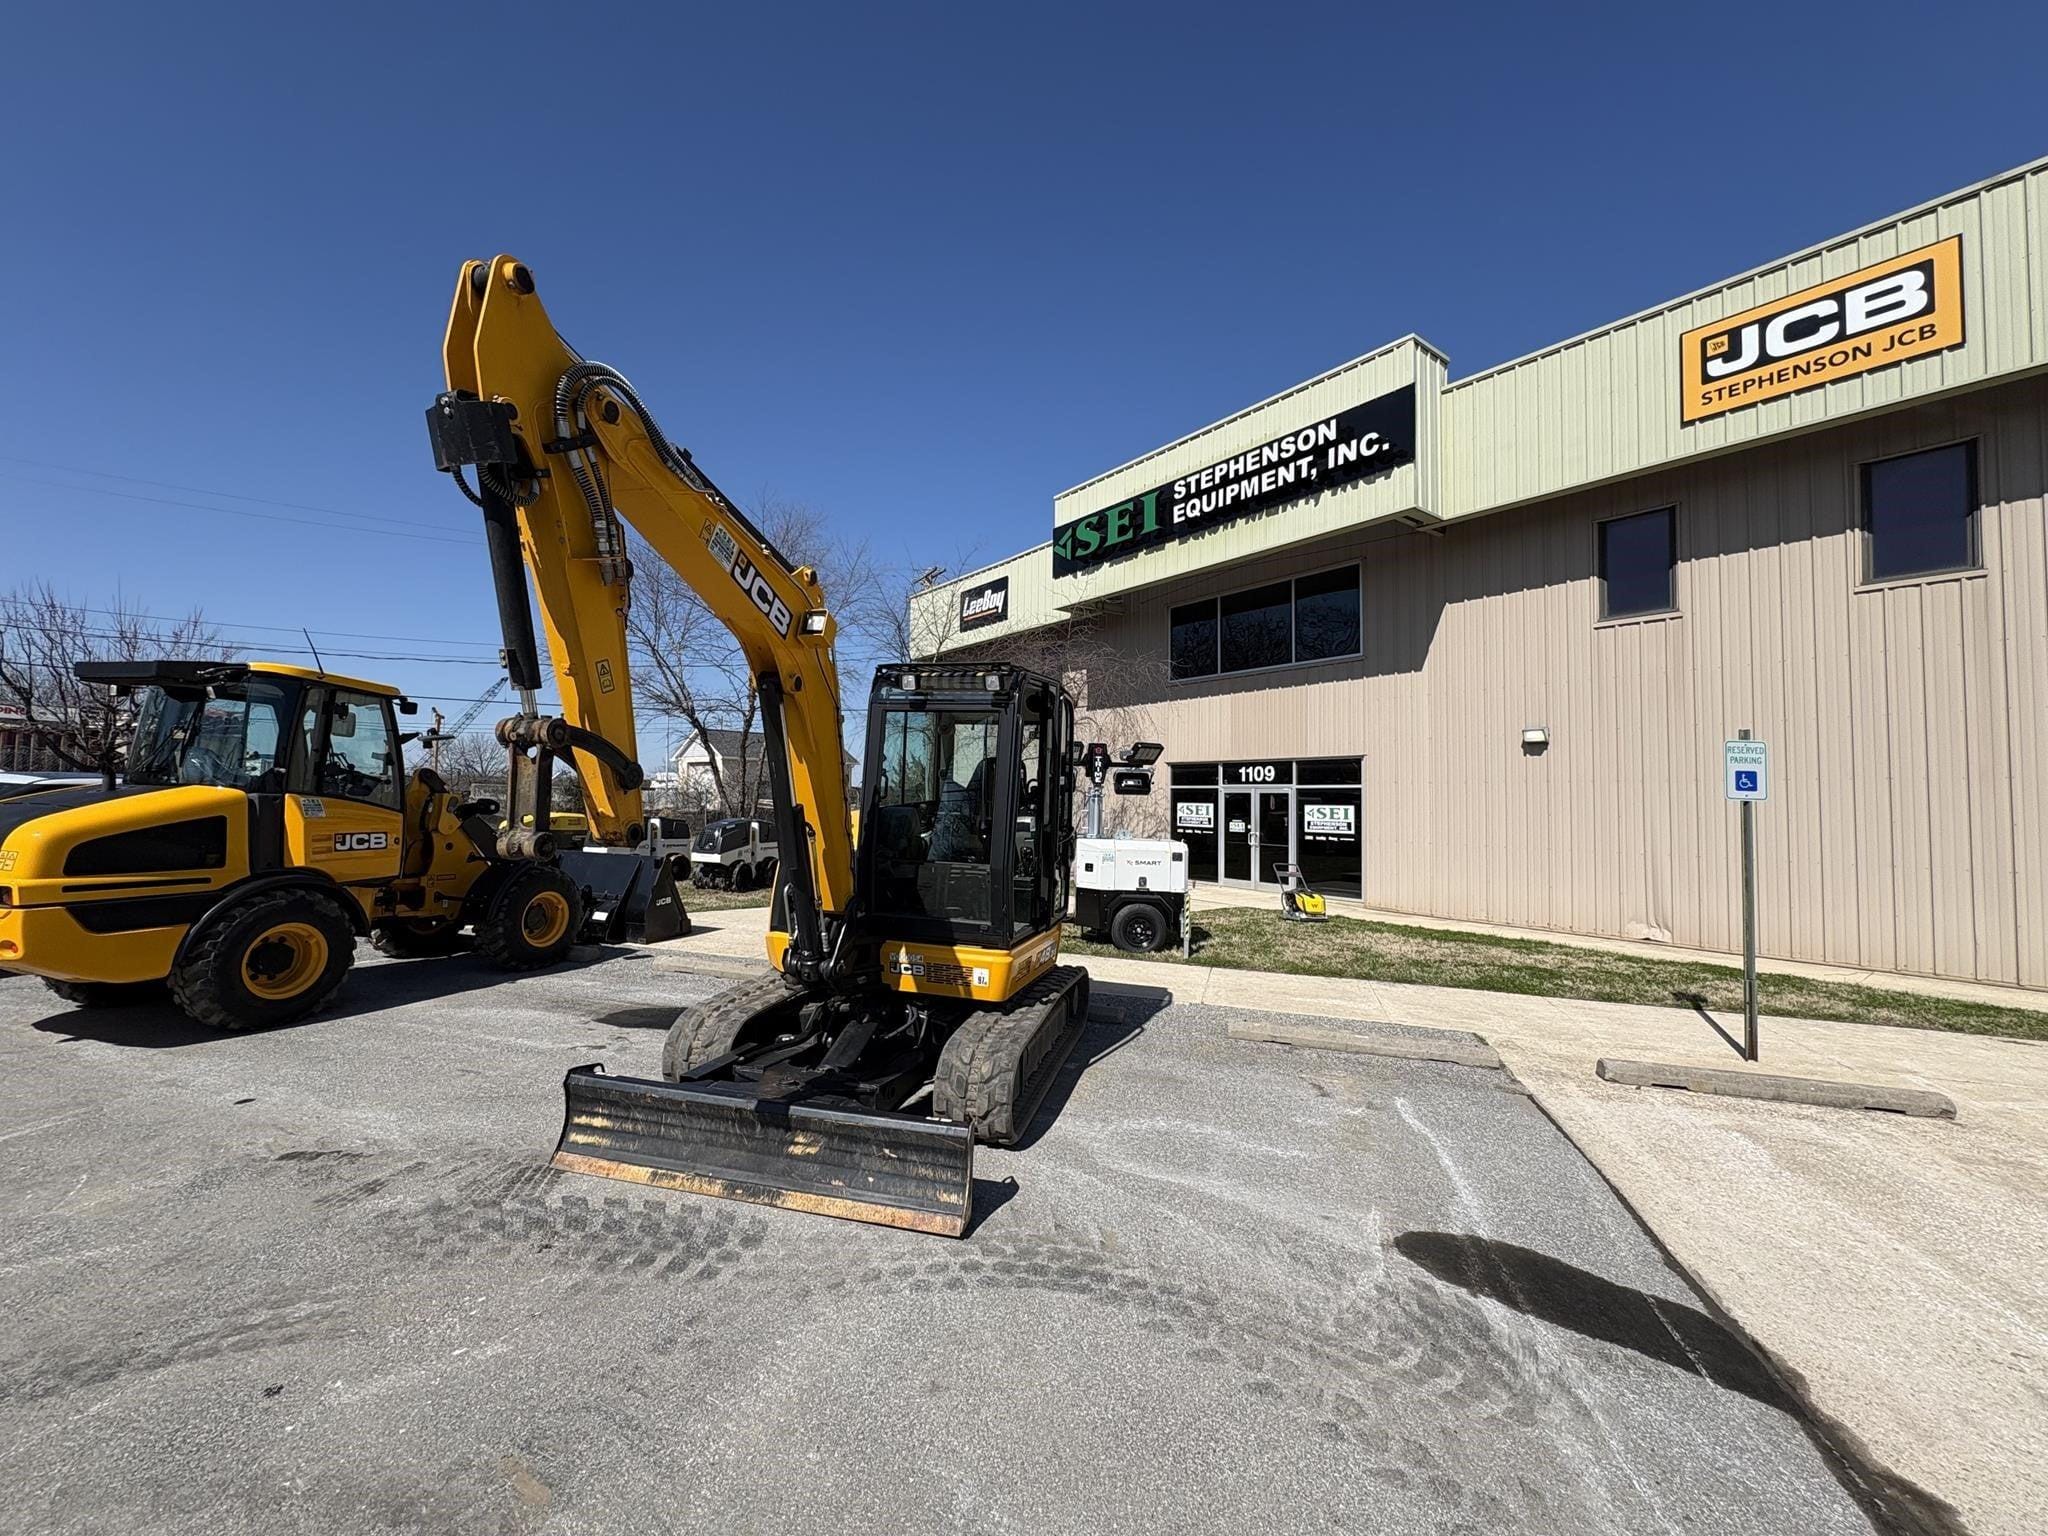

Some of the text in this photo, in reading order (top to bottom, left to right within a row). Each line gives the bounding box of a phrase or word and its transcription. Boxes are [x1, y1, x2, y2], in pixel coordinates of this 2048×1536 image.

[1707, 270, 1928, 377] JCB
[1701, 323, 1938, 406] STEPHENSON JCB
[1173, 419, 1337, 500] STEPHENSON
[1173, 432, 1390, 524] EQUIPMENT, INC.
[1075, 492, 1163, 557] SEI
[733, 564, 791, 636] JCB
[963, 589, 1006, 617] LeeBoy
[1728, 746, 1764, 755] RESERVED
[1730, 756, 1762, 764] PARKING
[1239, 766, 1275, 782] 1109
[1186, 804, 1210, 815] SEI
[1316, 807, 1350, 820] SEI
[335, 834, 387, 850] JCB
[656, 897, 671, 906] JCB
[890, 963, 924, 975] JCB
